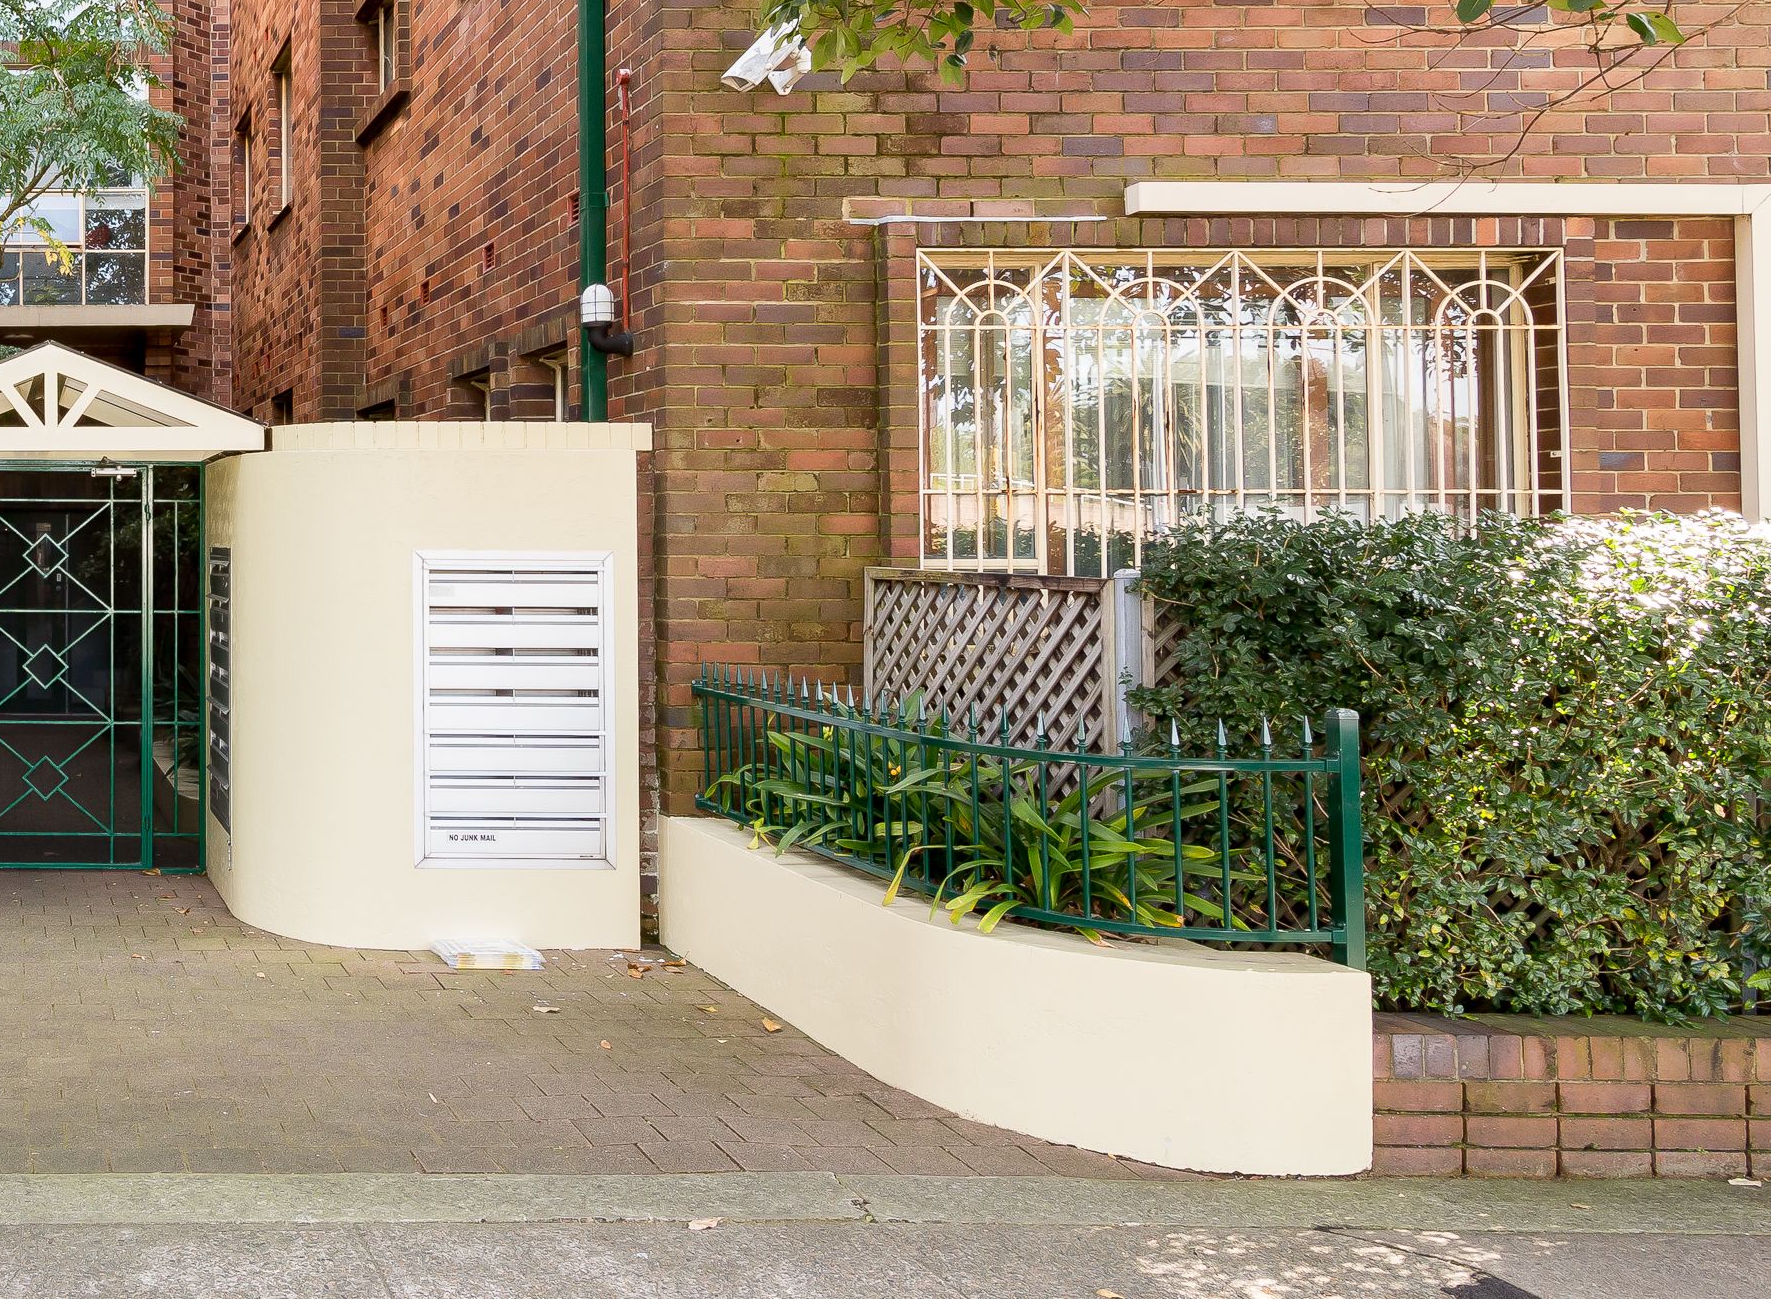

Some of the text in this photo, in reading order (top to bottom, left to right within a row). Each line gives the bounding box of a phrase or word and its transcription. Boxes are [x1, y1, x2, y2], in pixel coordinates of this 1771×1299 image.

[449, 834, 497, 842] NO JUNK MAIL
